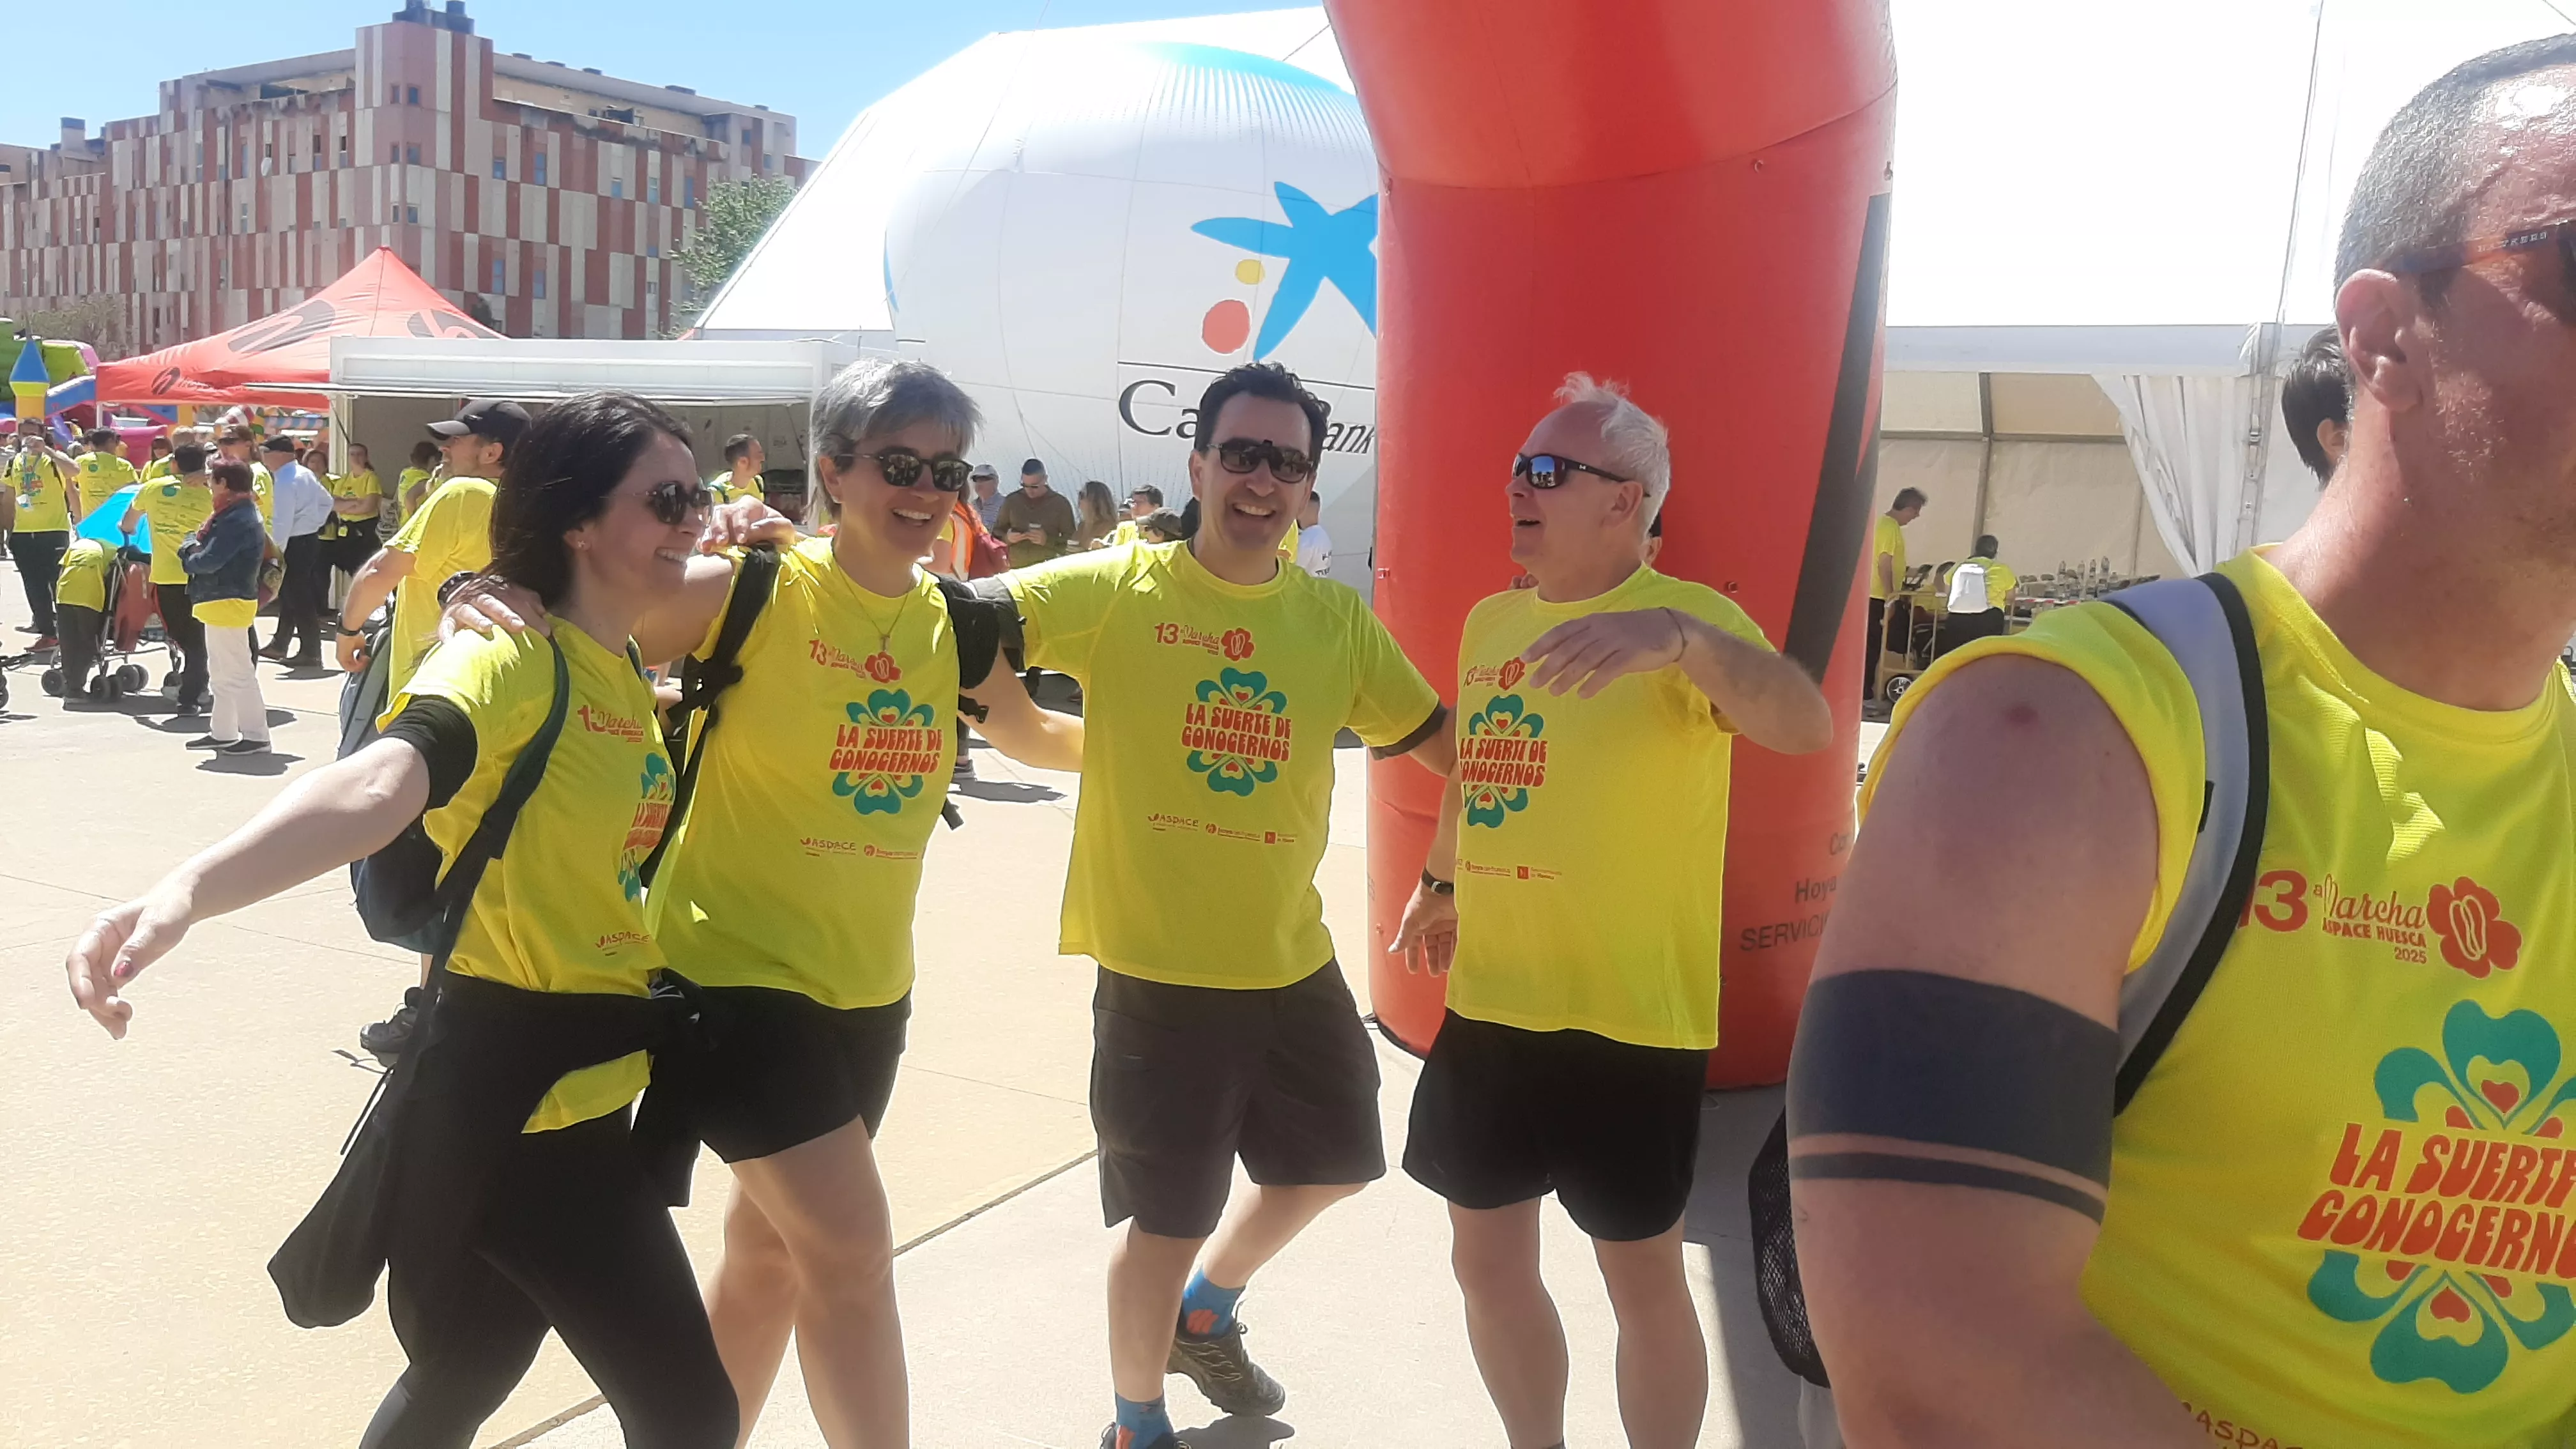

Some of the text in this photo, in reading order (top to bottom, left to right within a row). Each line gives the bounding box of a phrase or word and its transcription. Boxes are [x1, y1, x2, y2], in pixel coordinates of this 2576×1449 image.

[1186, 703, 1292, 739] LA SUERTE DE
[836, 724, 942, 752] LA SUERTE DE
[1181, 725, 1290, 762] CONOCERNOS
[1460, 738, 1548, 763] LA SUERTE DE
[829, 748, 940, 774] CONOCERNOS
[1795, 876, 1837, 905] Hoya
[2323, 873, 2426, 929] Marcha
[2322, 917, 2428, 948] ASPACE HUESCA
[2395, 947, 2428, 964] 2025
[2329, 1123, 2402, 1192] LA
